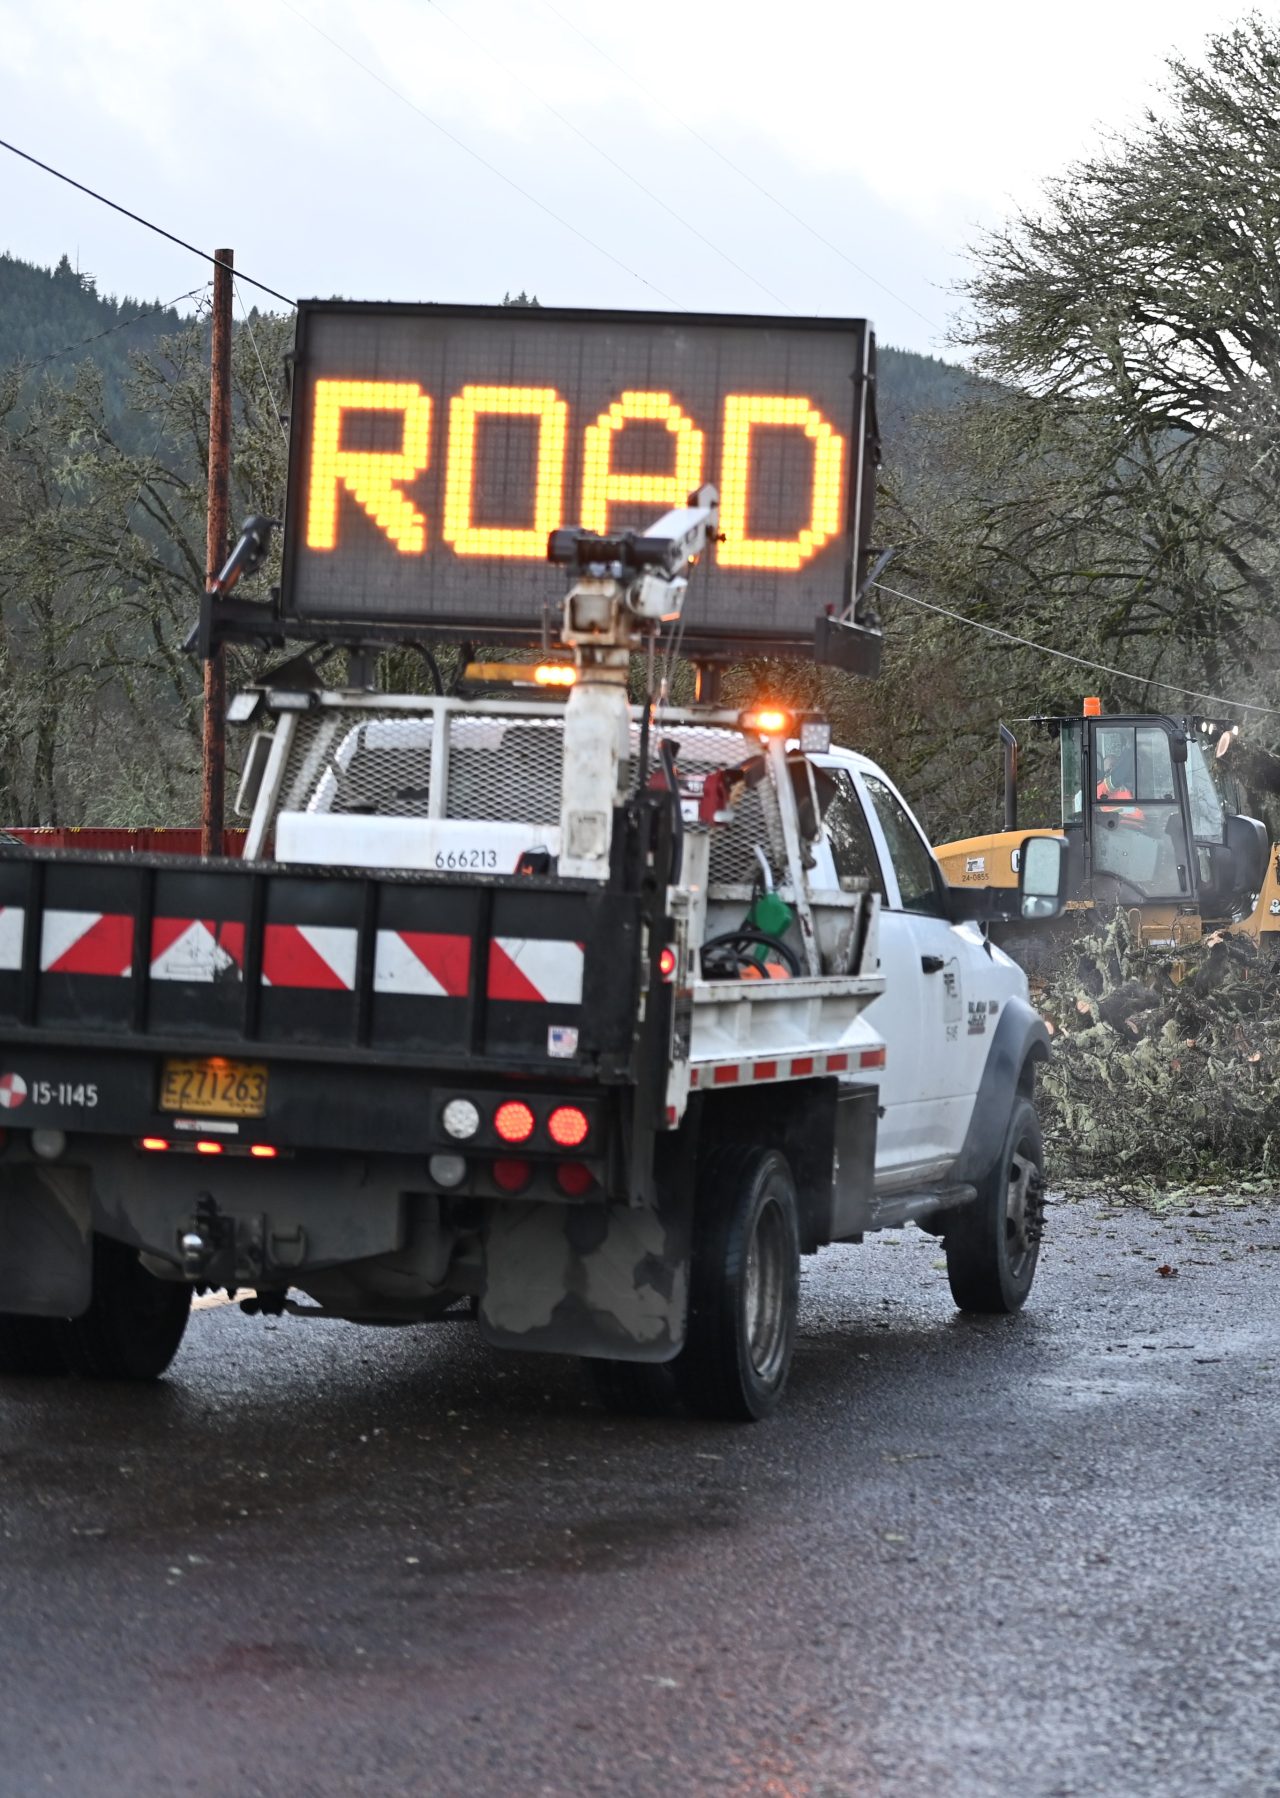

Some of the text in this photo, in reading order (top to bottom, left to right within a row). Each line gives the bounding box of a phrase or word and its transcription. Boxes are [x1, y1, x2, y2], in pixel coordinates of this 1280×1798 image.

[306, 379, 846, 570] ROAD
[435, 850, 497, 868] 666213
[32, 1081, 98, 1107] 15-1145
[165, 1069, 266, 1103] E271263
